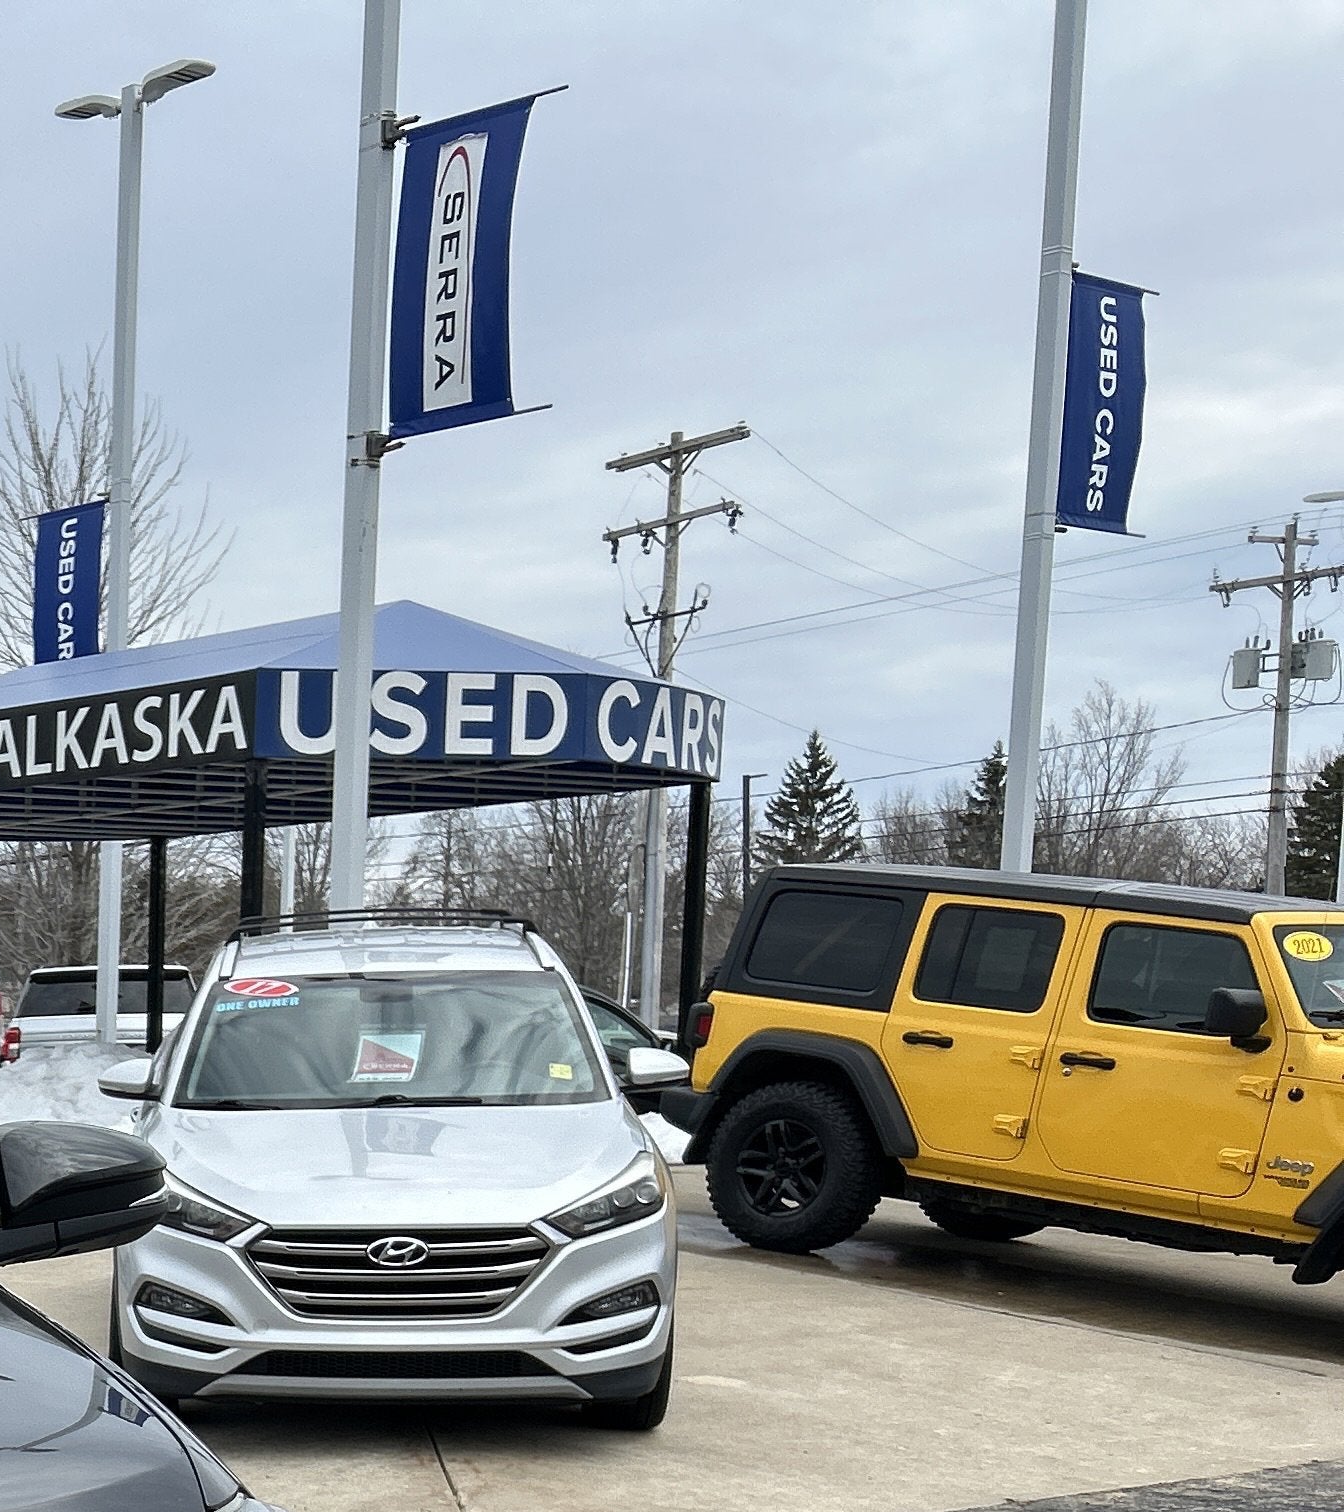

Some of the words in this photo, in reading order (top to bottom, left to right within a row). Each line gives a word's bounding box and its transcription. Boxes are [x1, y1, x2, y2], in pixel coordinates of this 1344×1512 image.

[434, 191, 465, 391] SERRA
[1099, 296, 1118, 398] USED
[1086, 408, 1114, 513] CARS
[57, 517, 78, 595] USED
[57, 601, 75, 661] CAR
[279, 670, 568, 756] USED
[597, 680, 723, 777] CARS
[1292, 938, 1325, 955] 2021
[216, 1001, 244, 1012] ONE
[247, 997, 300, 1009] OWNER
